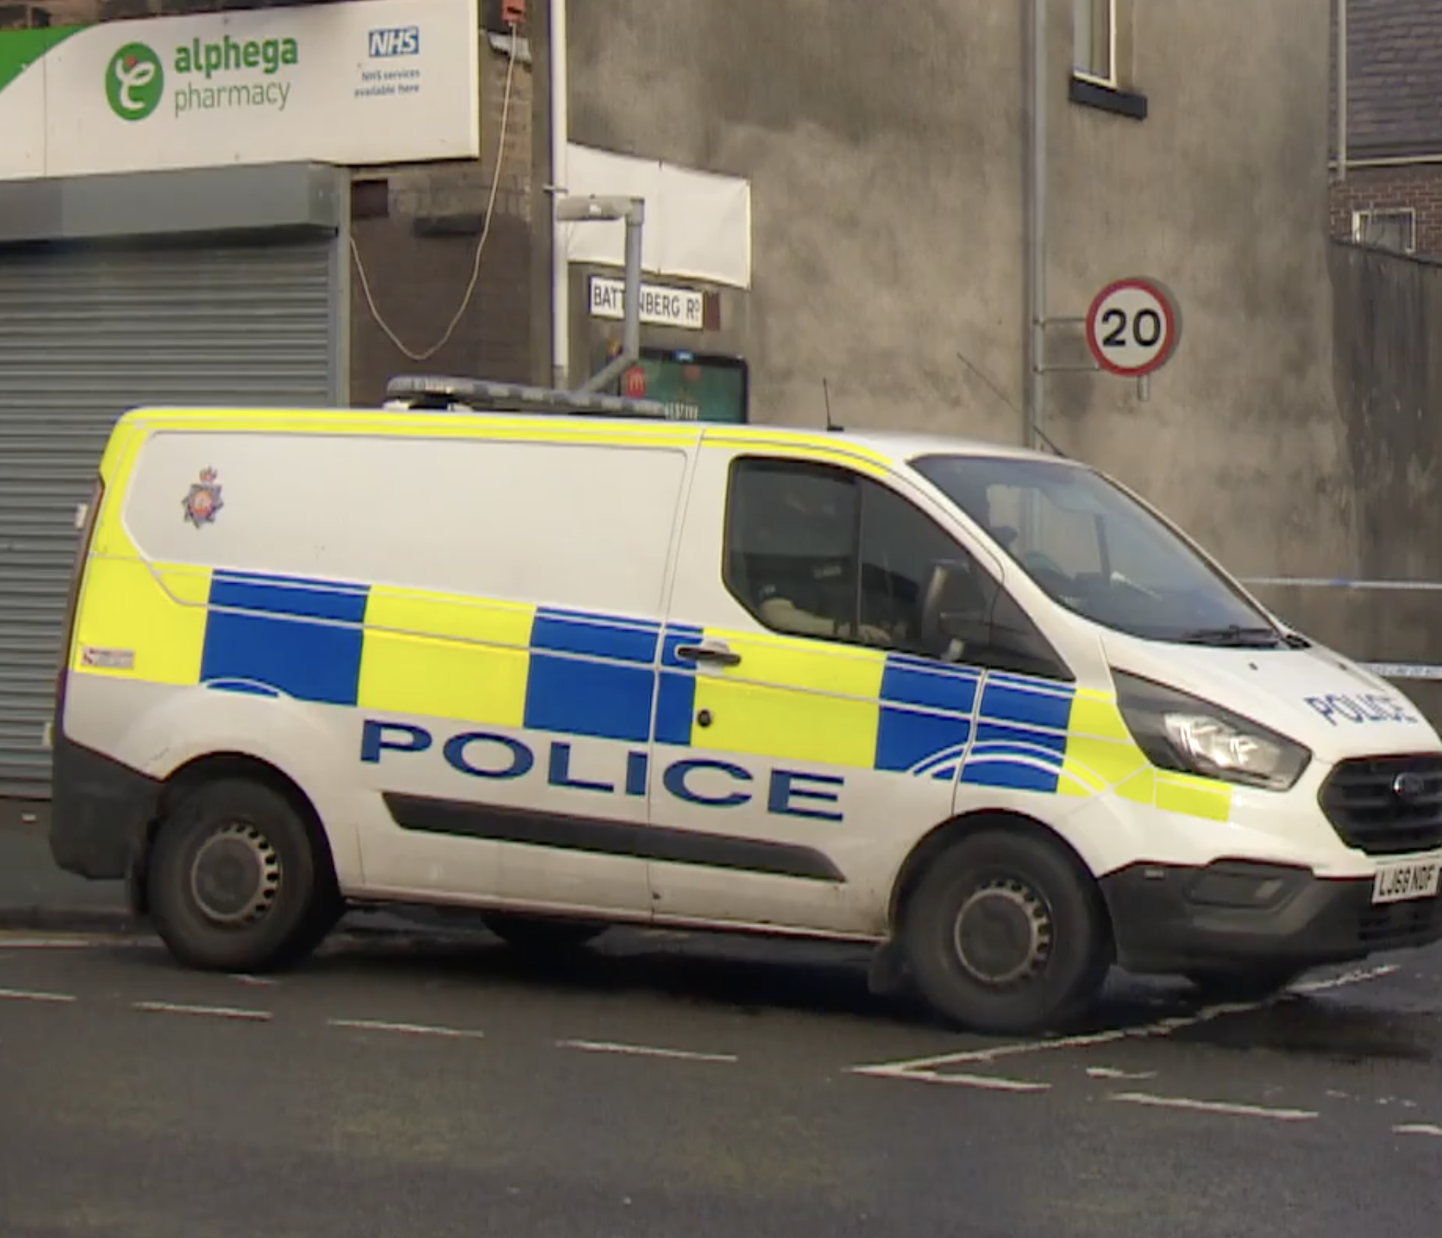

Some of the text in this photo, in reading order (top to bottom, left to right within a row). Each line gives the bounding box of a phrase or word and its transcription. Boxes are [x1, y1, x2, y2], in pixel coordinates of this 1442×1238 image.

[174, 35, 298, 79] alphega
[370, 28, 417, 56] NHS
[354, 83, 419, 97] available here
[362, 69, 420, 81] NHS services
[175, 81, 290, 118] pharmacy
[594, 285, 680, 319] BATTNBERG
[1101, 308, 1161, 347] 20
[1303, 694, 1419, 726] POLICE
[360, 719, 845, 822] POLICE
